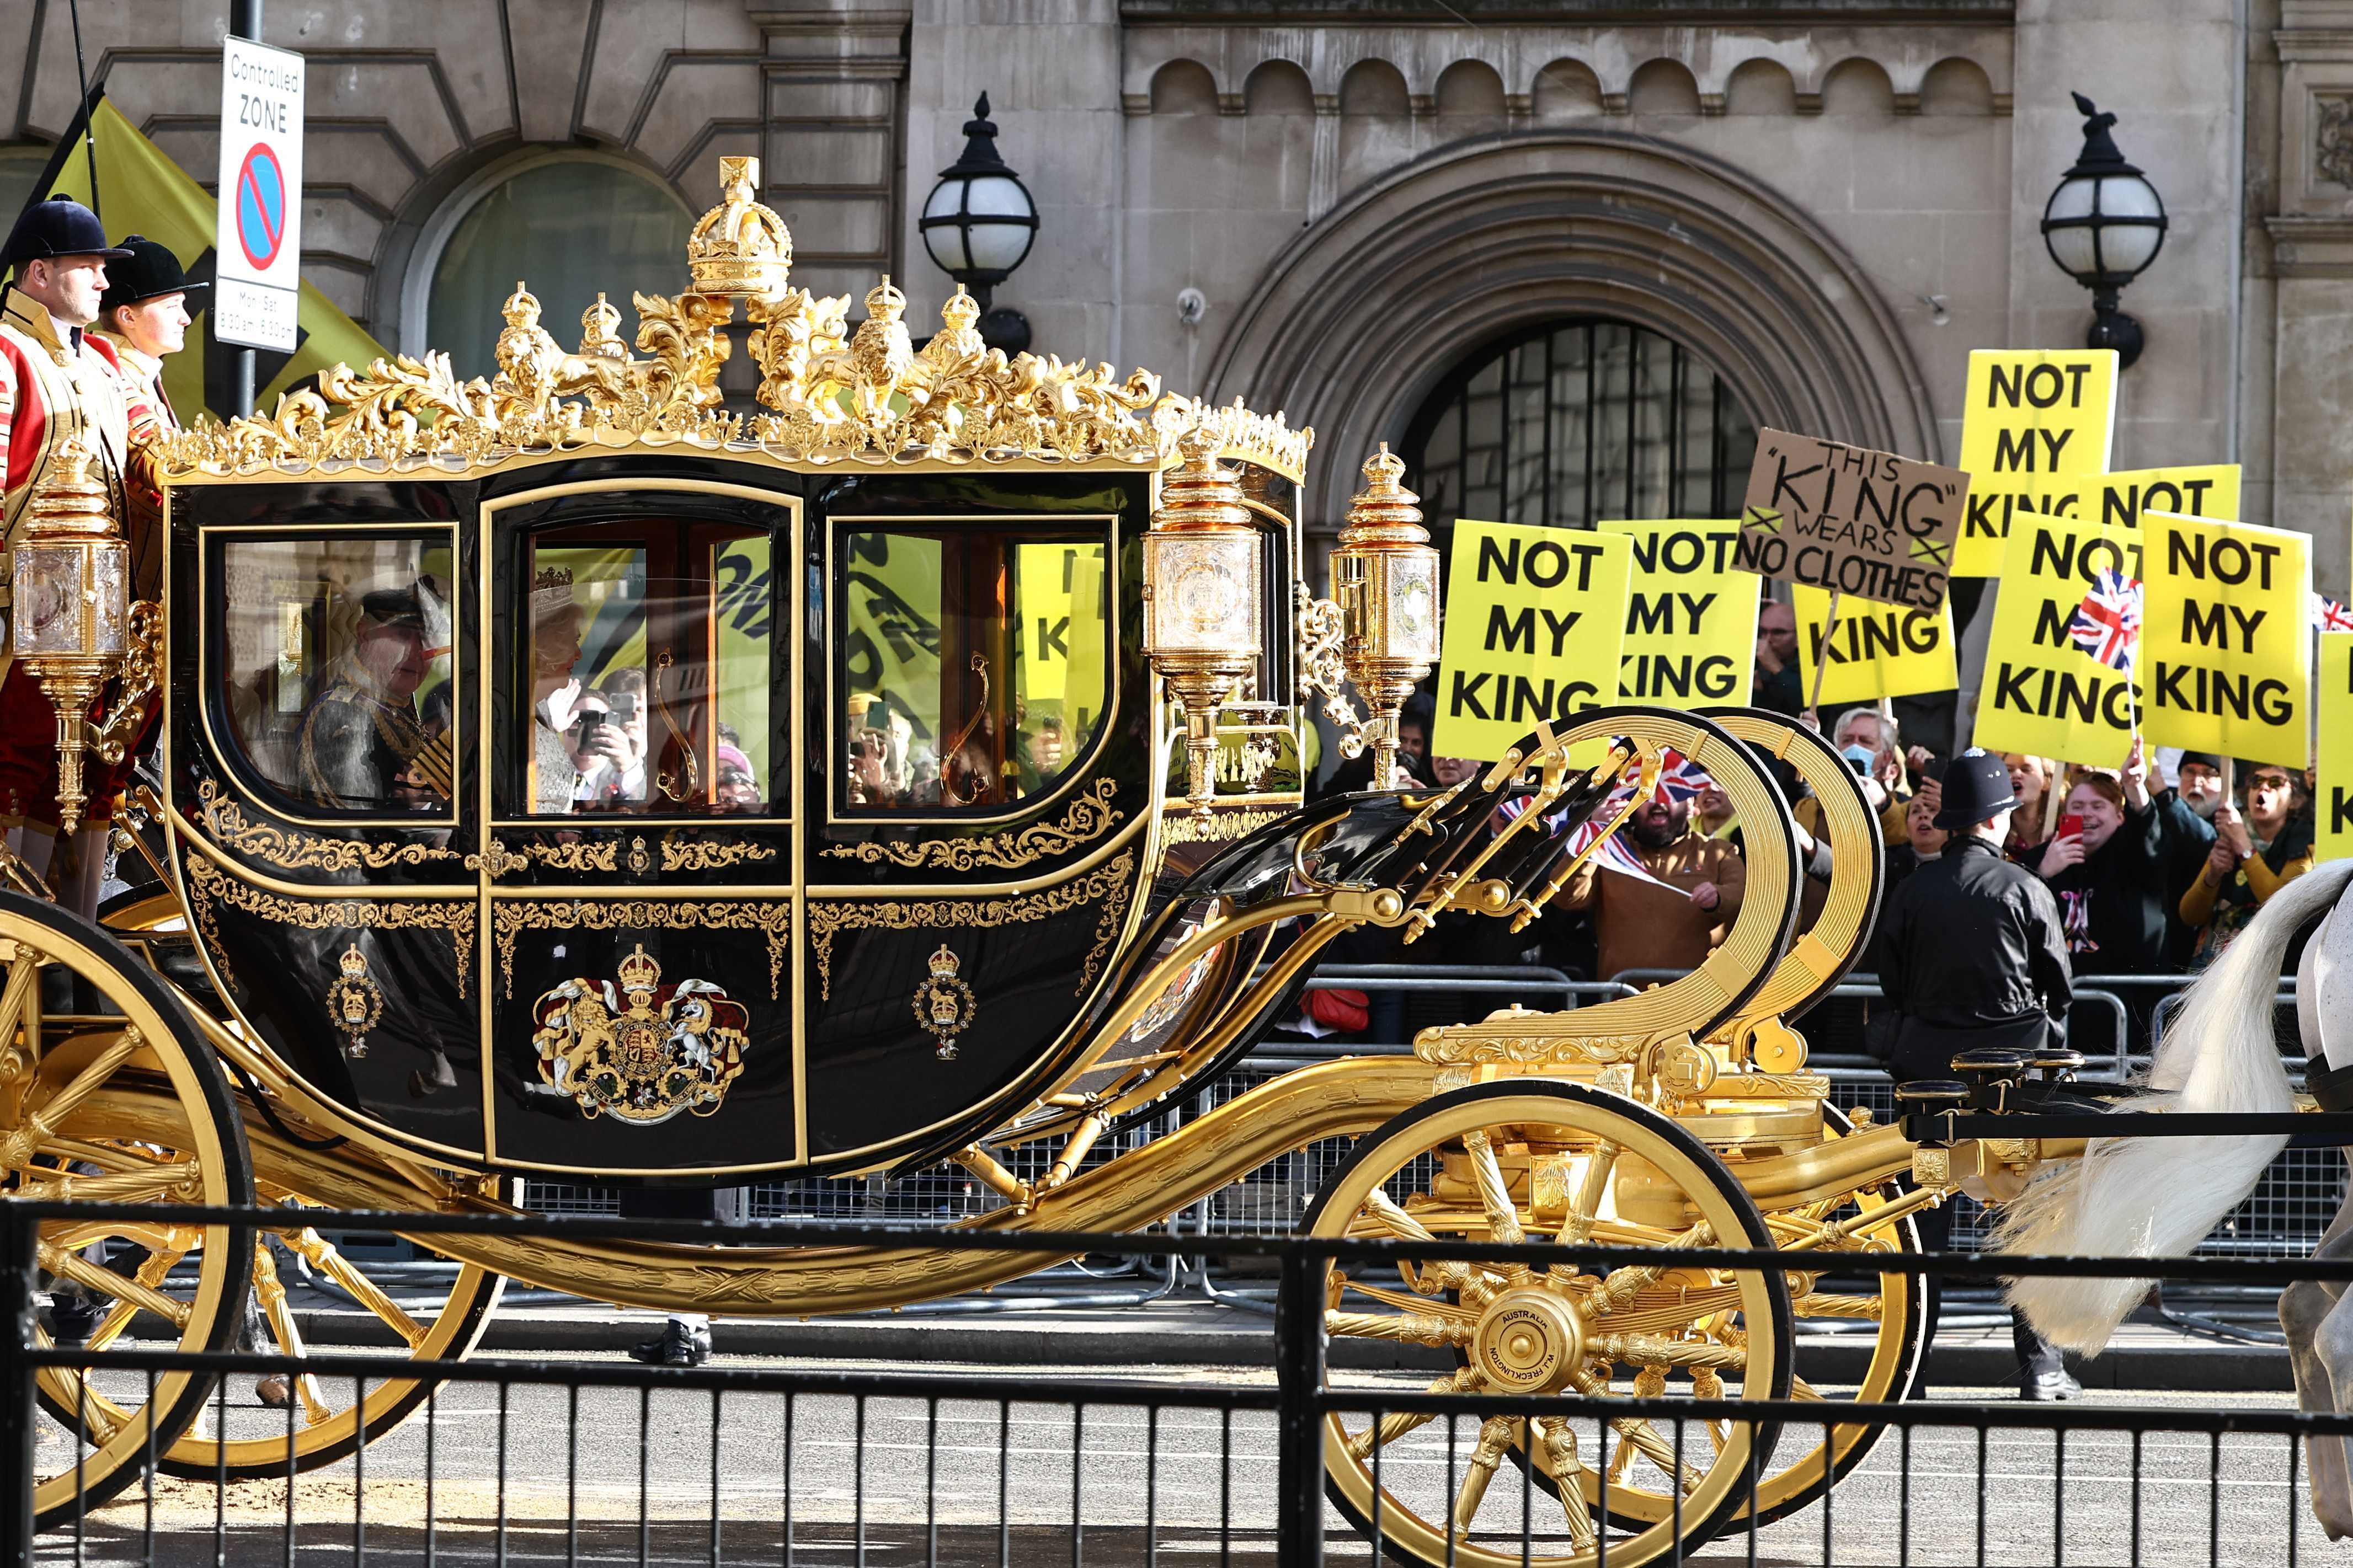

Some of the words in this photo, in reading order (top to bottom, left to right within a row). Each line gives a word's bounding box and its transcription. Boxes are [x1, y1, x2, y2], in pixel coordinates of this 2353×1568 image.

[231, 53, 298, 93] Controlled
[240, 93, 286, 133] ZONE
[239, 291, 256, 308] Mon
[264, 295, 277, 312] Sat
[1988, 363, 2091, 408] NOT
[1818, 442, 1901, 481] THIS
[1993, 429, 2074, 473] MY
[1768, 447, 1956, 537] "KING"
[1794, 510, 1898, 555] WEARS
[1477, 536, 1604, 592] NOT
[1733, 532, 1788, 575] NO
[1795, 545, 1946, 608] CLOTHES
[2168, 530, 2280, 590] NOT
[1484, 604, 1582, 657] MY
[1626, 593, 1717, 634] MY
[2032, 598, 2083, 651] M
[2181, 598, 2267, 654] MY
[1810, 609, 1940, 666] KING
[1994, 662, 2143, 730] KING
[2156, 661, 2293, 726] KING
[585, 1079, 600, 1095] DIEU
[669, 1095, 684, 1104] MON
[1502, 1310, 1548, 1329] AUSTRALIA
[1490, 1347, 1544, 1380] FRECKLINGTON
